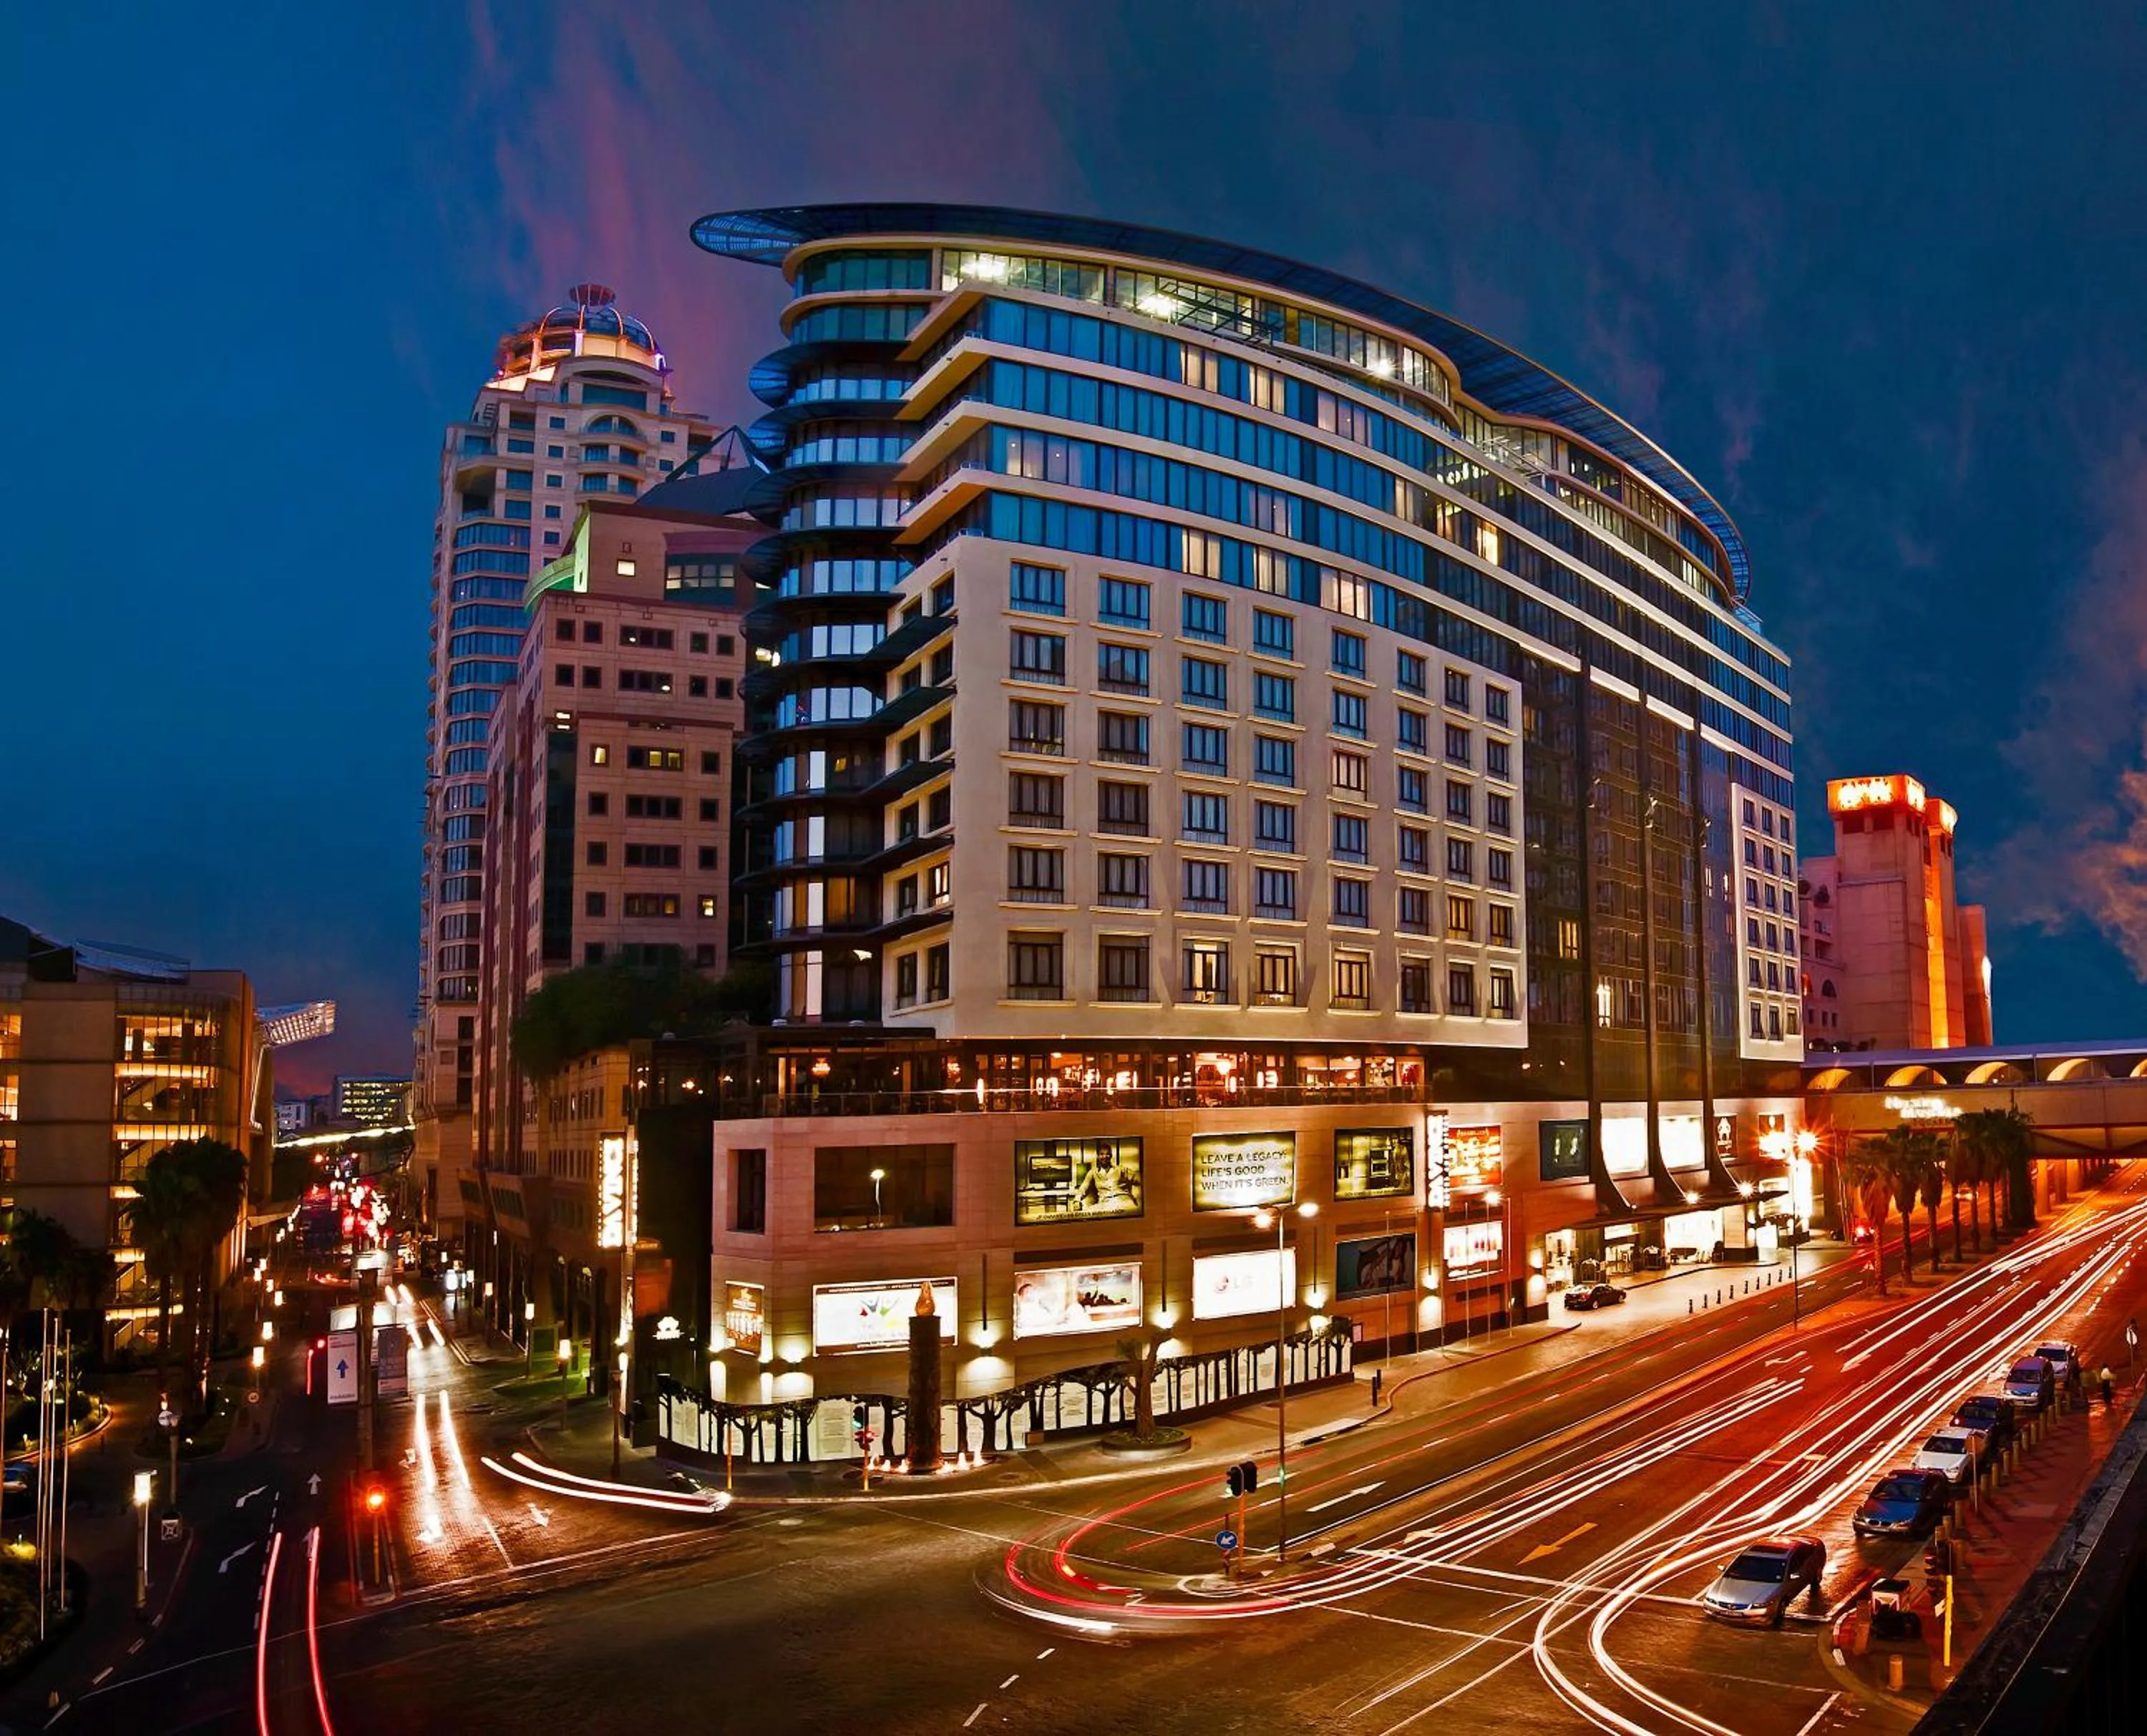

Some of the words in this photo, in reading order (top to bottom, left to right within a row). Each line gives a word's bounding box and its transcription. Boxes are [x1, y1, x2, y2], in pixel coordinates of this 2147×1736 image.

[1201, 1154, 1234, 1164] LEAVE
[1201, 1166, 1232, 1177] LIFE'S
[1235, 1166, 1265, 1176] GOOD
[1200, 1179, 1231, 1190] WHEN
[1235, 1179, 1252, 1188] IT'S
